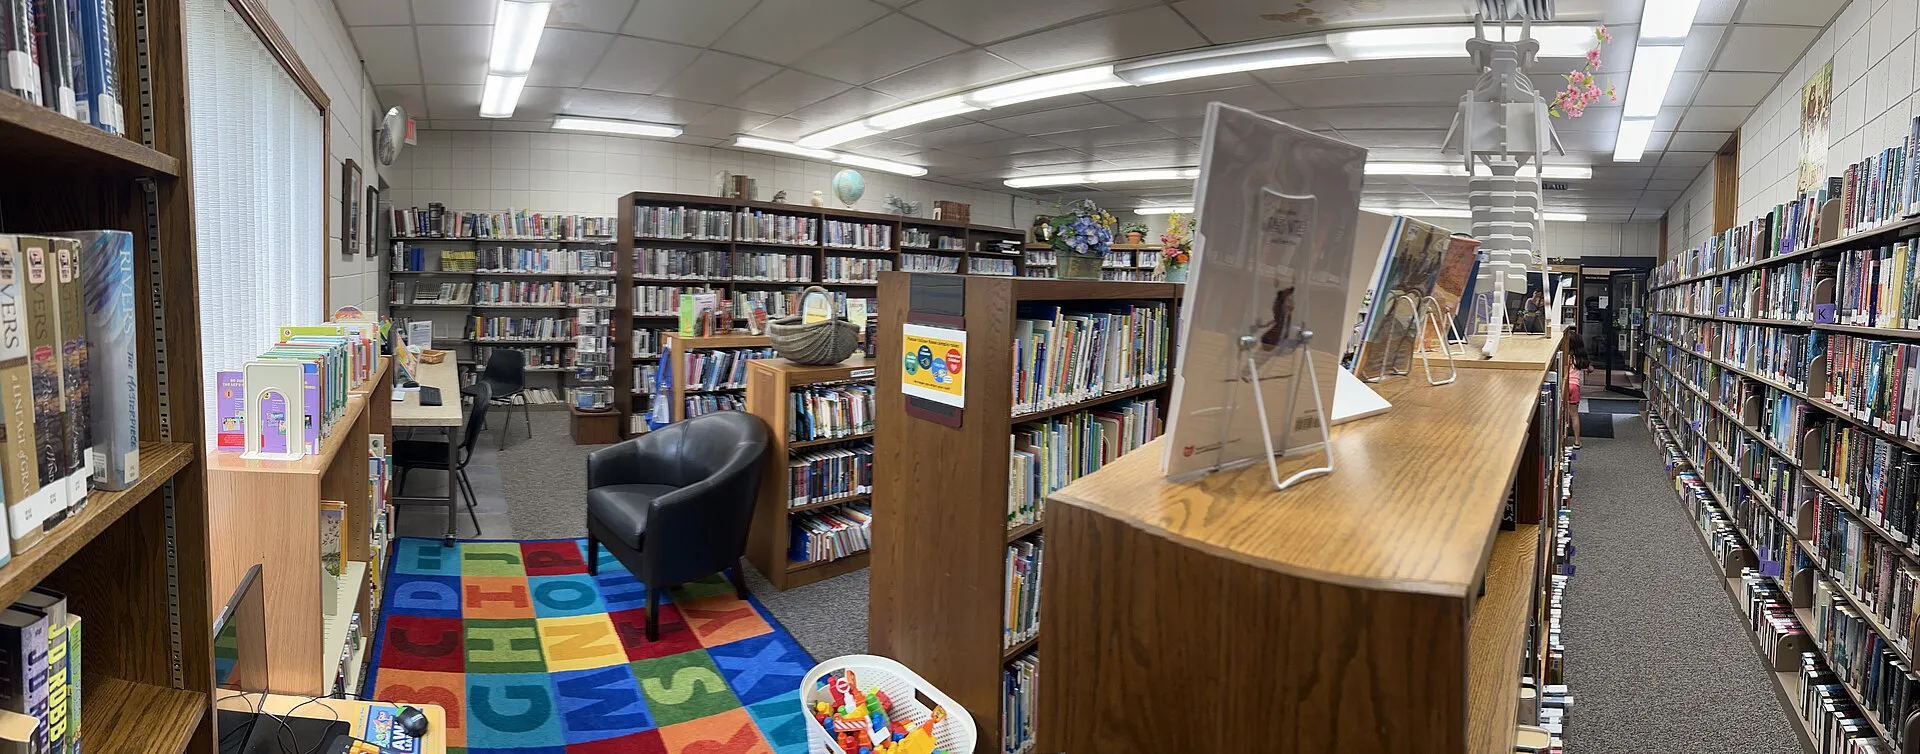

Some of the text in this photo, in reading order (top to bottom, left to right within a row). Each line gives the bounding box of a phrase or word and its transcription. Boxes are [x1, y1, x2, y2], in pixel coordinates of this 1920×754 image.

[1782, 241, 1789, 250] H
[119, 249, 133, 335] RIVERS
[0, 283, 20, 350] VERS
[30, 284, 48, 340] VERS
[1818, 308, 1826, 320] K
[11, 384, 27, 447] LINEAGE
[127, 351, 138, 449] THE MASTERPIECE
[1880, 445, 1888, 472] STEPHEN
[465, 552, 521, 565] J
[527, 551, 583, 568] P
[393, 581, 458, 610] D
[466, 585, 529, 608] I
[534, 580, 597, 610] O
[543, 621, 619, 661] N
[618, 622, 684, 648] T
[684, 608, 755, 637] Y
[390, 628, 458, 657] C
[467, 627, 542, 662] H
[28, 650, 48, 699] J.D.
[48, 623, 67, 742] J.D. ROBB
[642, 666, 727, 705] S
[713, 640, 809, 696] X
[470, 685, 551, 733] G
[557, 665, 649, 731] M
